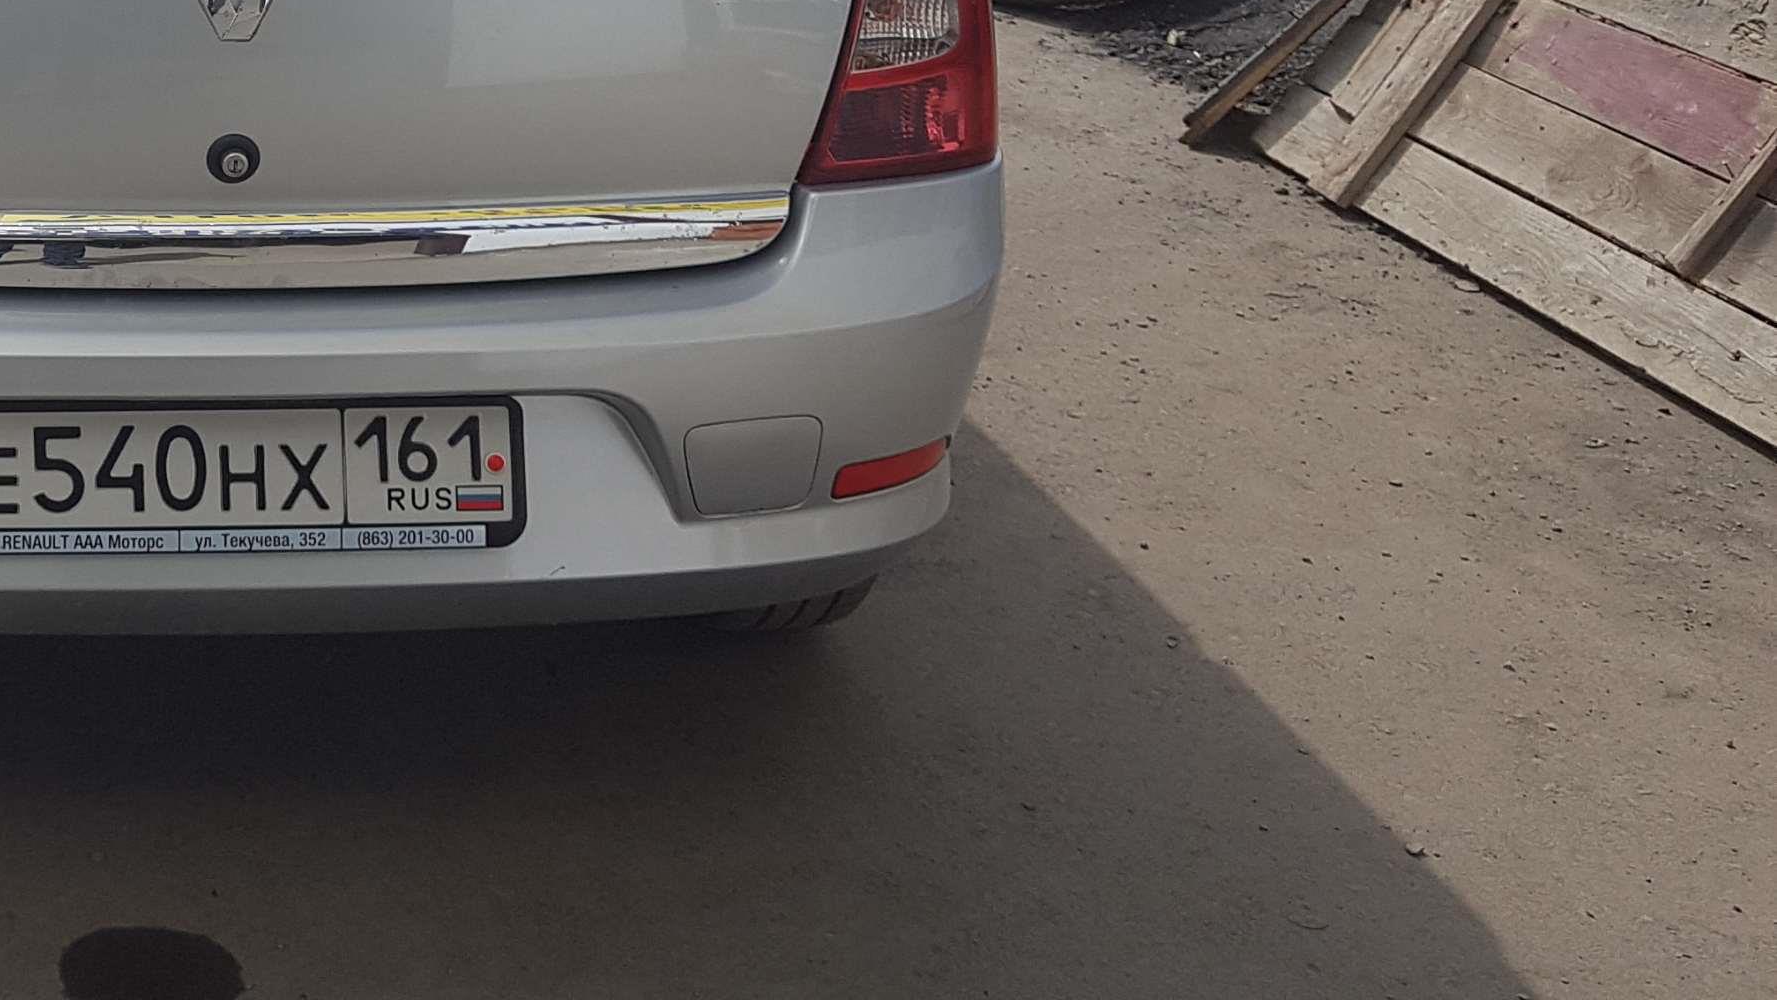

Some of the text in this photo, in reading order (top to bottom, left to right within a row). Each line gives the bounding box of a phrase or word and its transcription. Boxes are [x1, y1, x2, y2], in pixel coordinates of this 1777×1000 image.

[354, 415, 482, 482] 161
[387, 486, 453, 511] RUS
[1, 534, 70, 550] RENAULT
[108, 533, 164, 552] Моторс
[194, 532, 326, 551] ул. Текучева, 352
[357, 529, 474, 549] (863) 201-30-00
